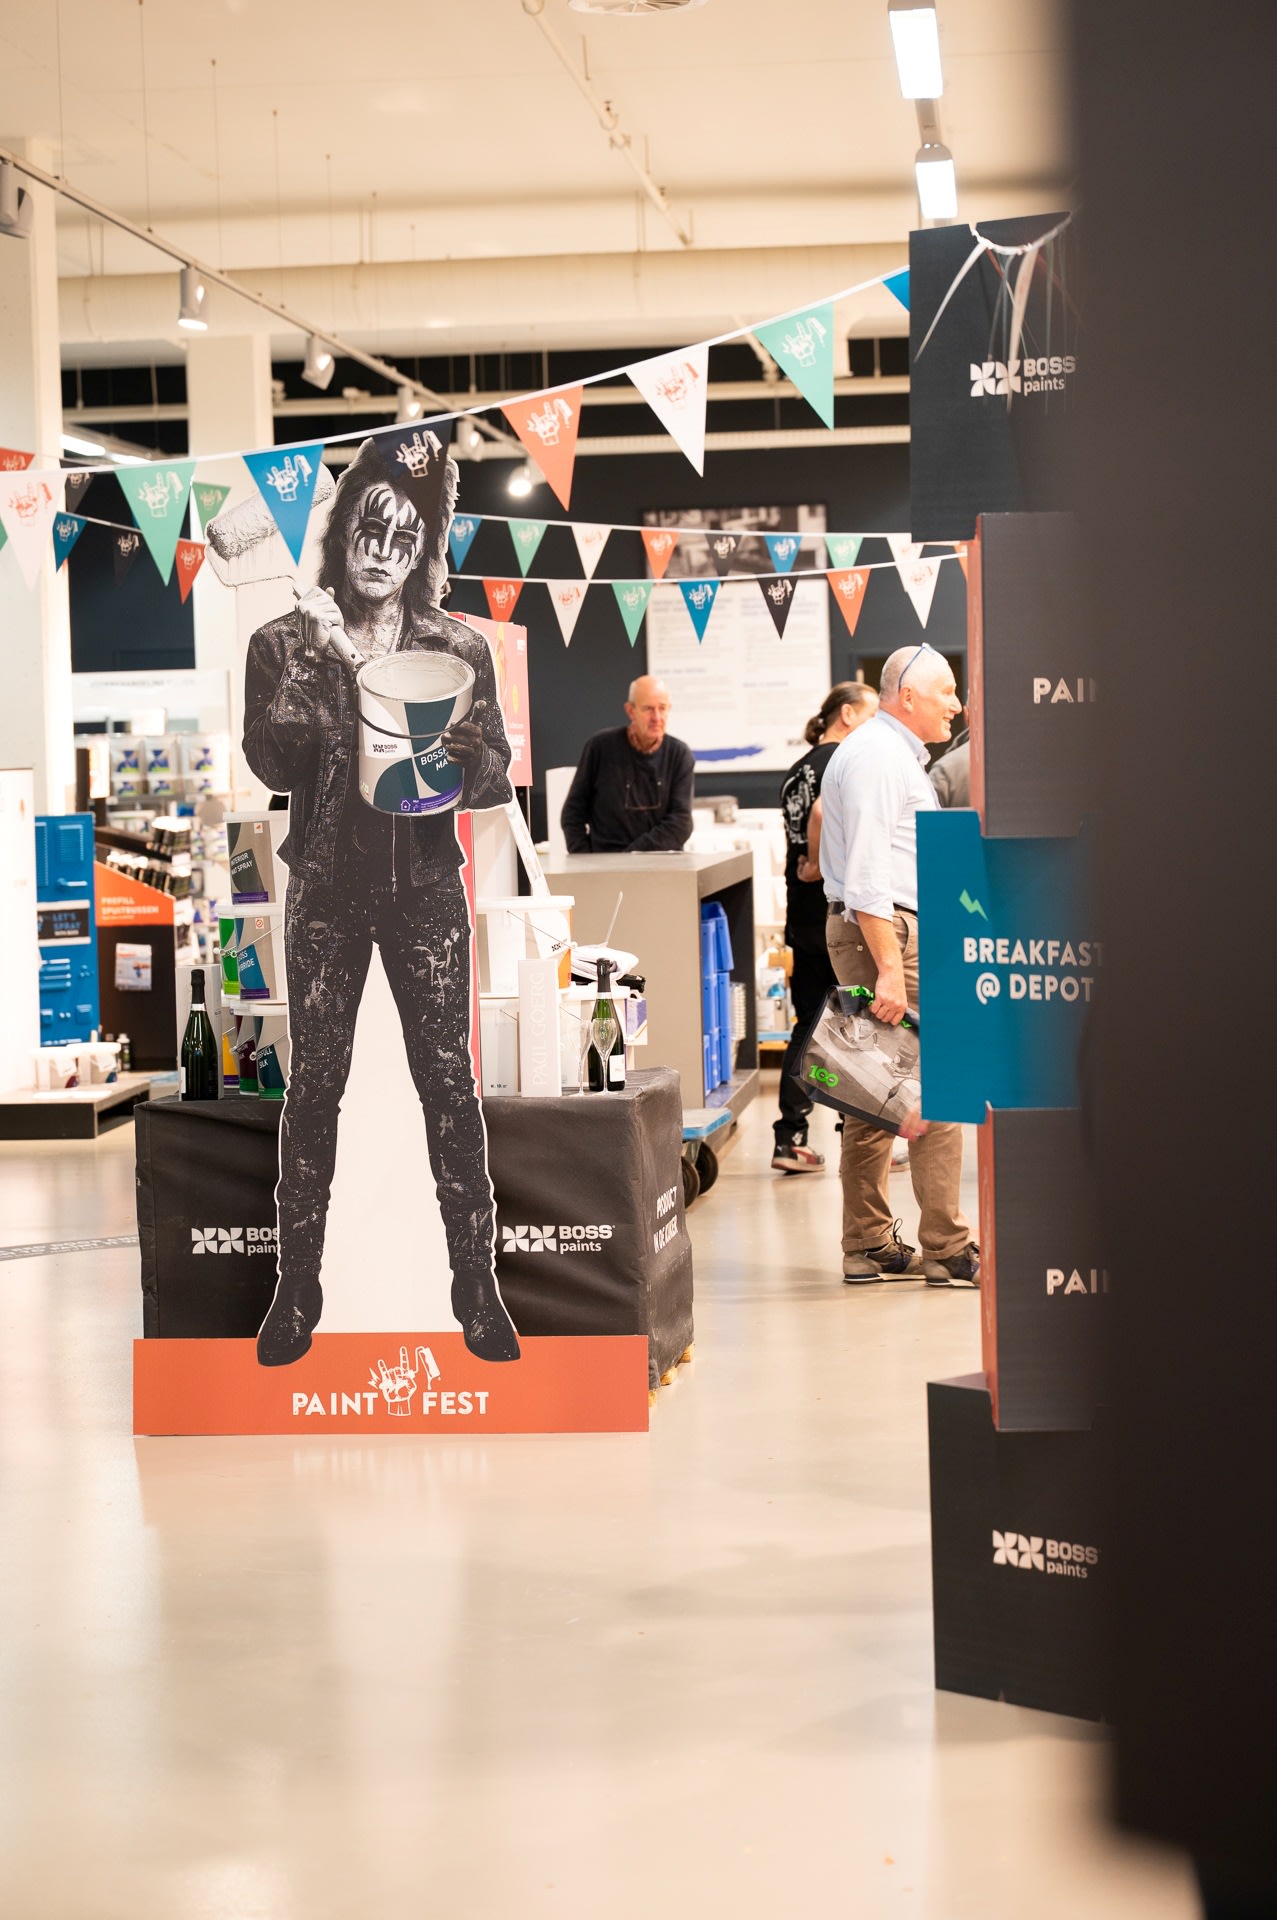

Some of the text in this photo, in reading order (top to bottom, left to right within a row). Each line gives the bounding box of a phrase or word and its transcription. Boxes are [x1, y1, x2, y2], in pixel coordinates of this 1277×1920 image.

[1023, 355, 1077, 377] BOSS
[1023, 377, 1065, 397] paints
[435, 758, 449, 771] MA
[237, 860, 253, 872] SPRAY
[963, 937, 1105, 966] BREAKFAST
[975, 972, 1095, 1005] @ DEPOT
[258, 1059, 269, 1069] SILK
[809, 1064, 840, 1088] 100
[559, 1224, 613, 1240] BOSS
[559, 1240, 602, 1255] paints
[292, 1391, 489, 1416] PAINT FEST
[1046, 1539, 1099, 1565] BOSS
[1046, 1560, 1088, 1579] paints
